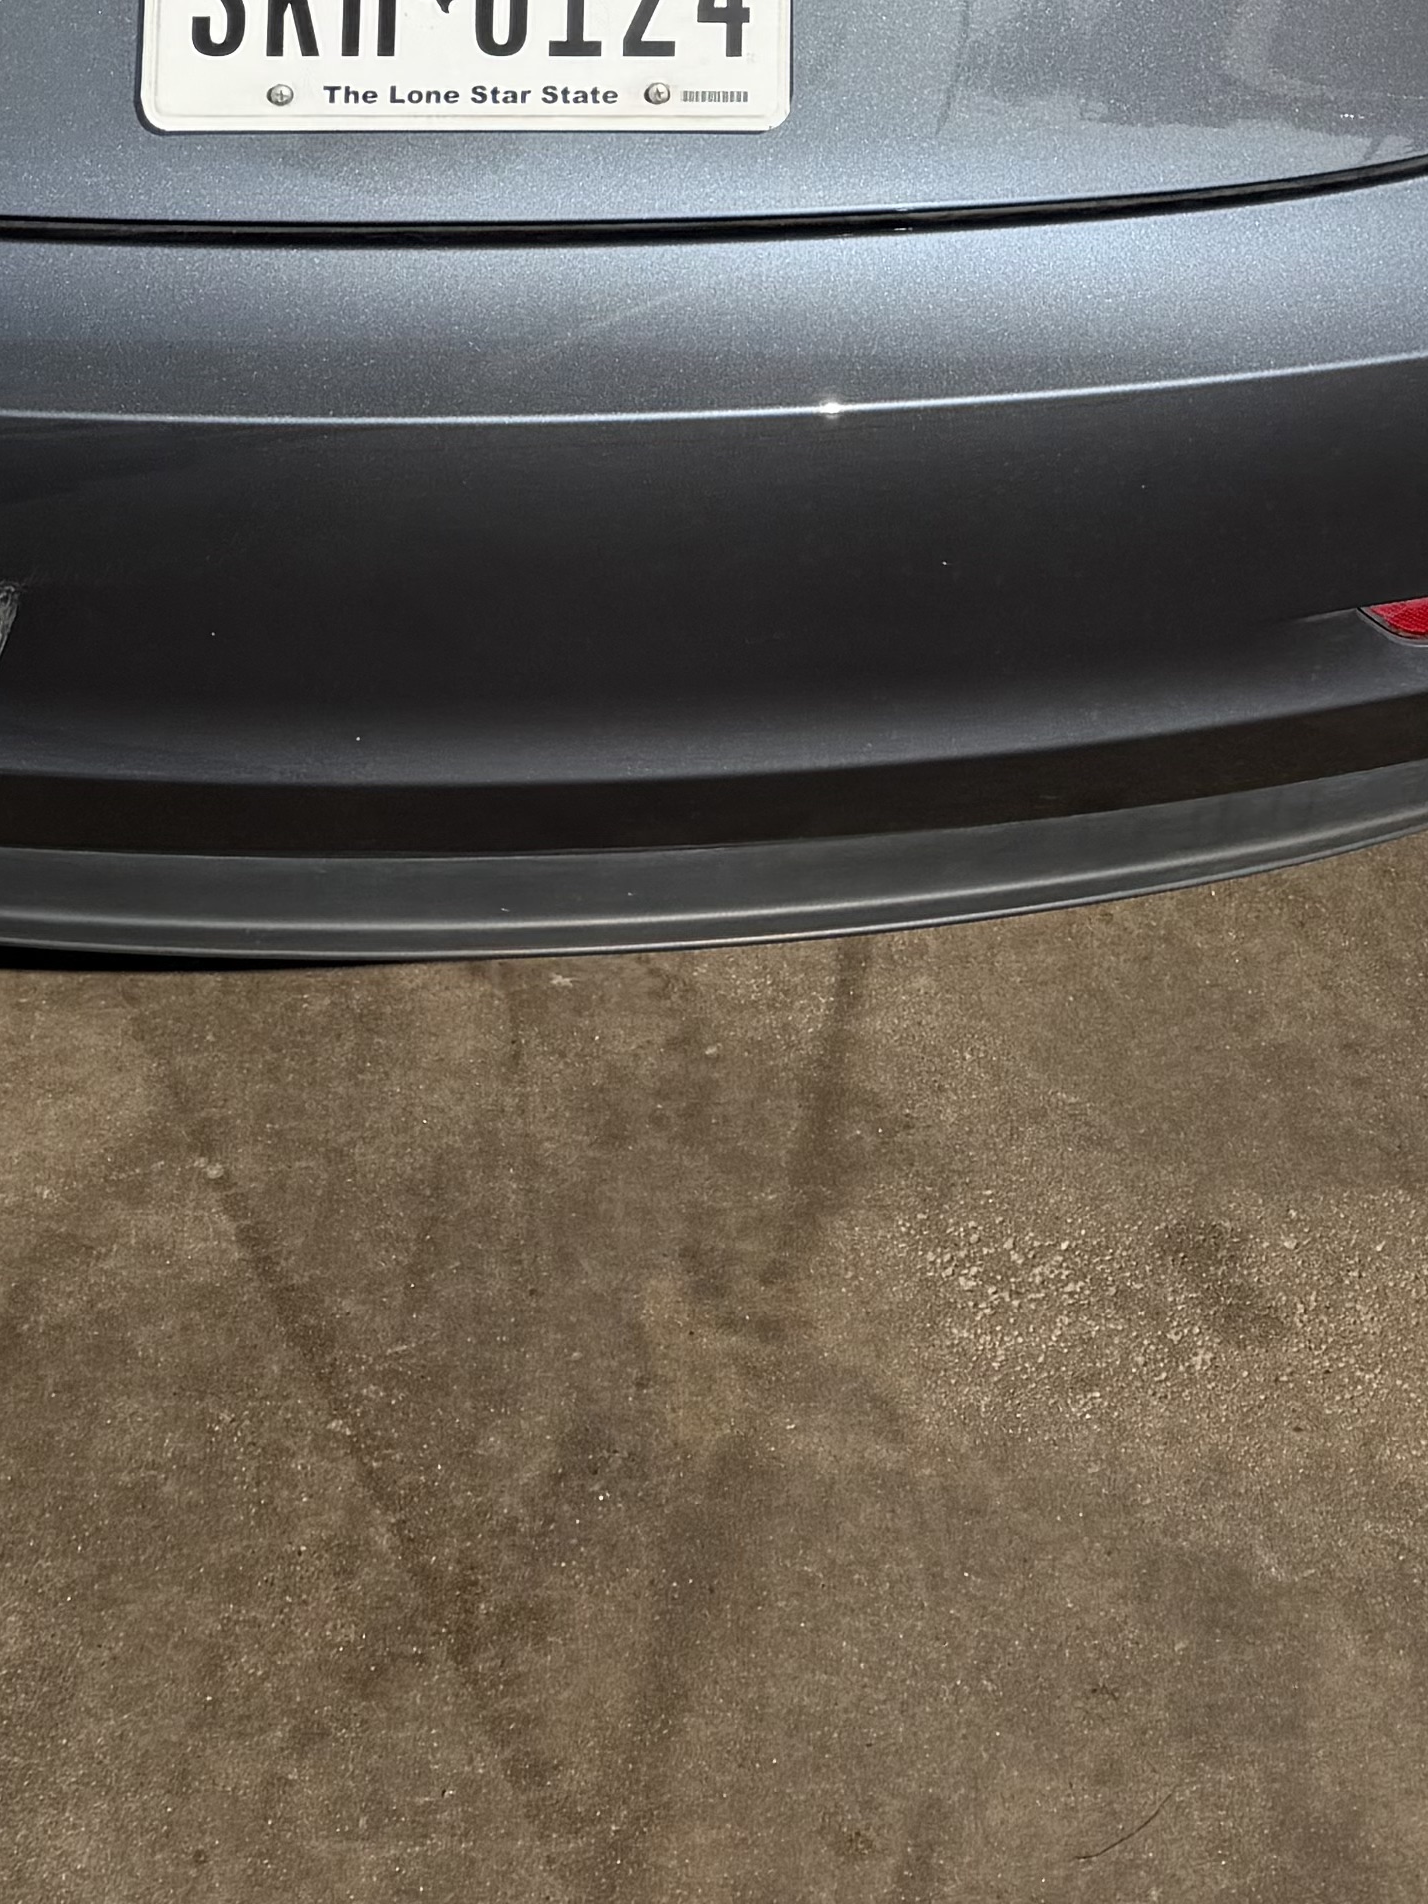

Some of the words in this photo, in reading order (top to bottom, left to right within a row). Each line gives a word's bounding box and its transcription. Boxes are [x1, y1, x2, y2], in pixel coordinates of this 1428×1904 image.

[323, 85, 377, 104] The
[389, 85, 459, 104] Lone
[471, 85, 532, 104] Star
[541, 85, 618, 104] State
